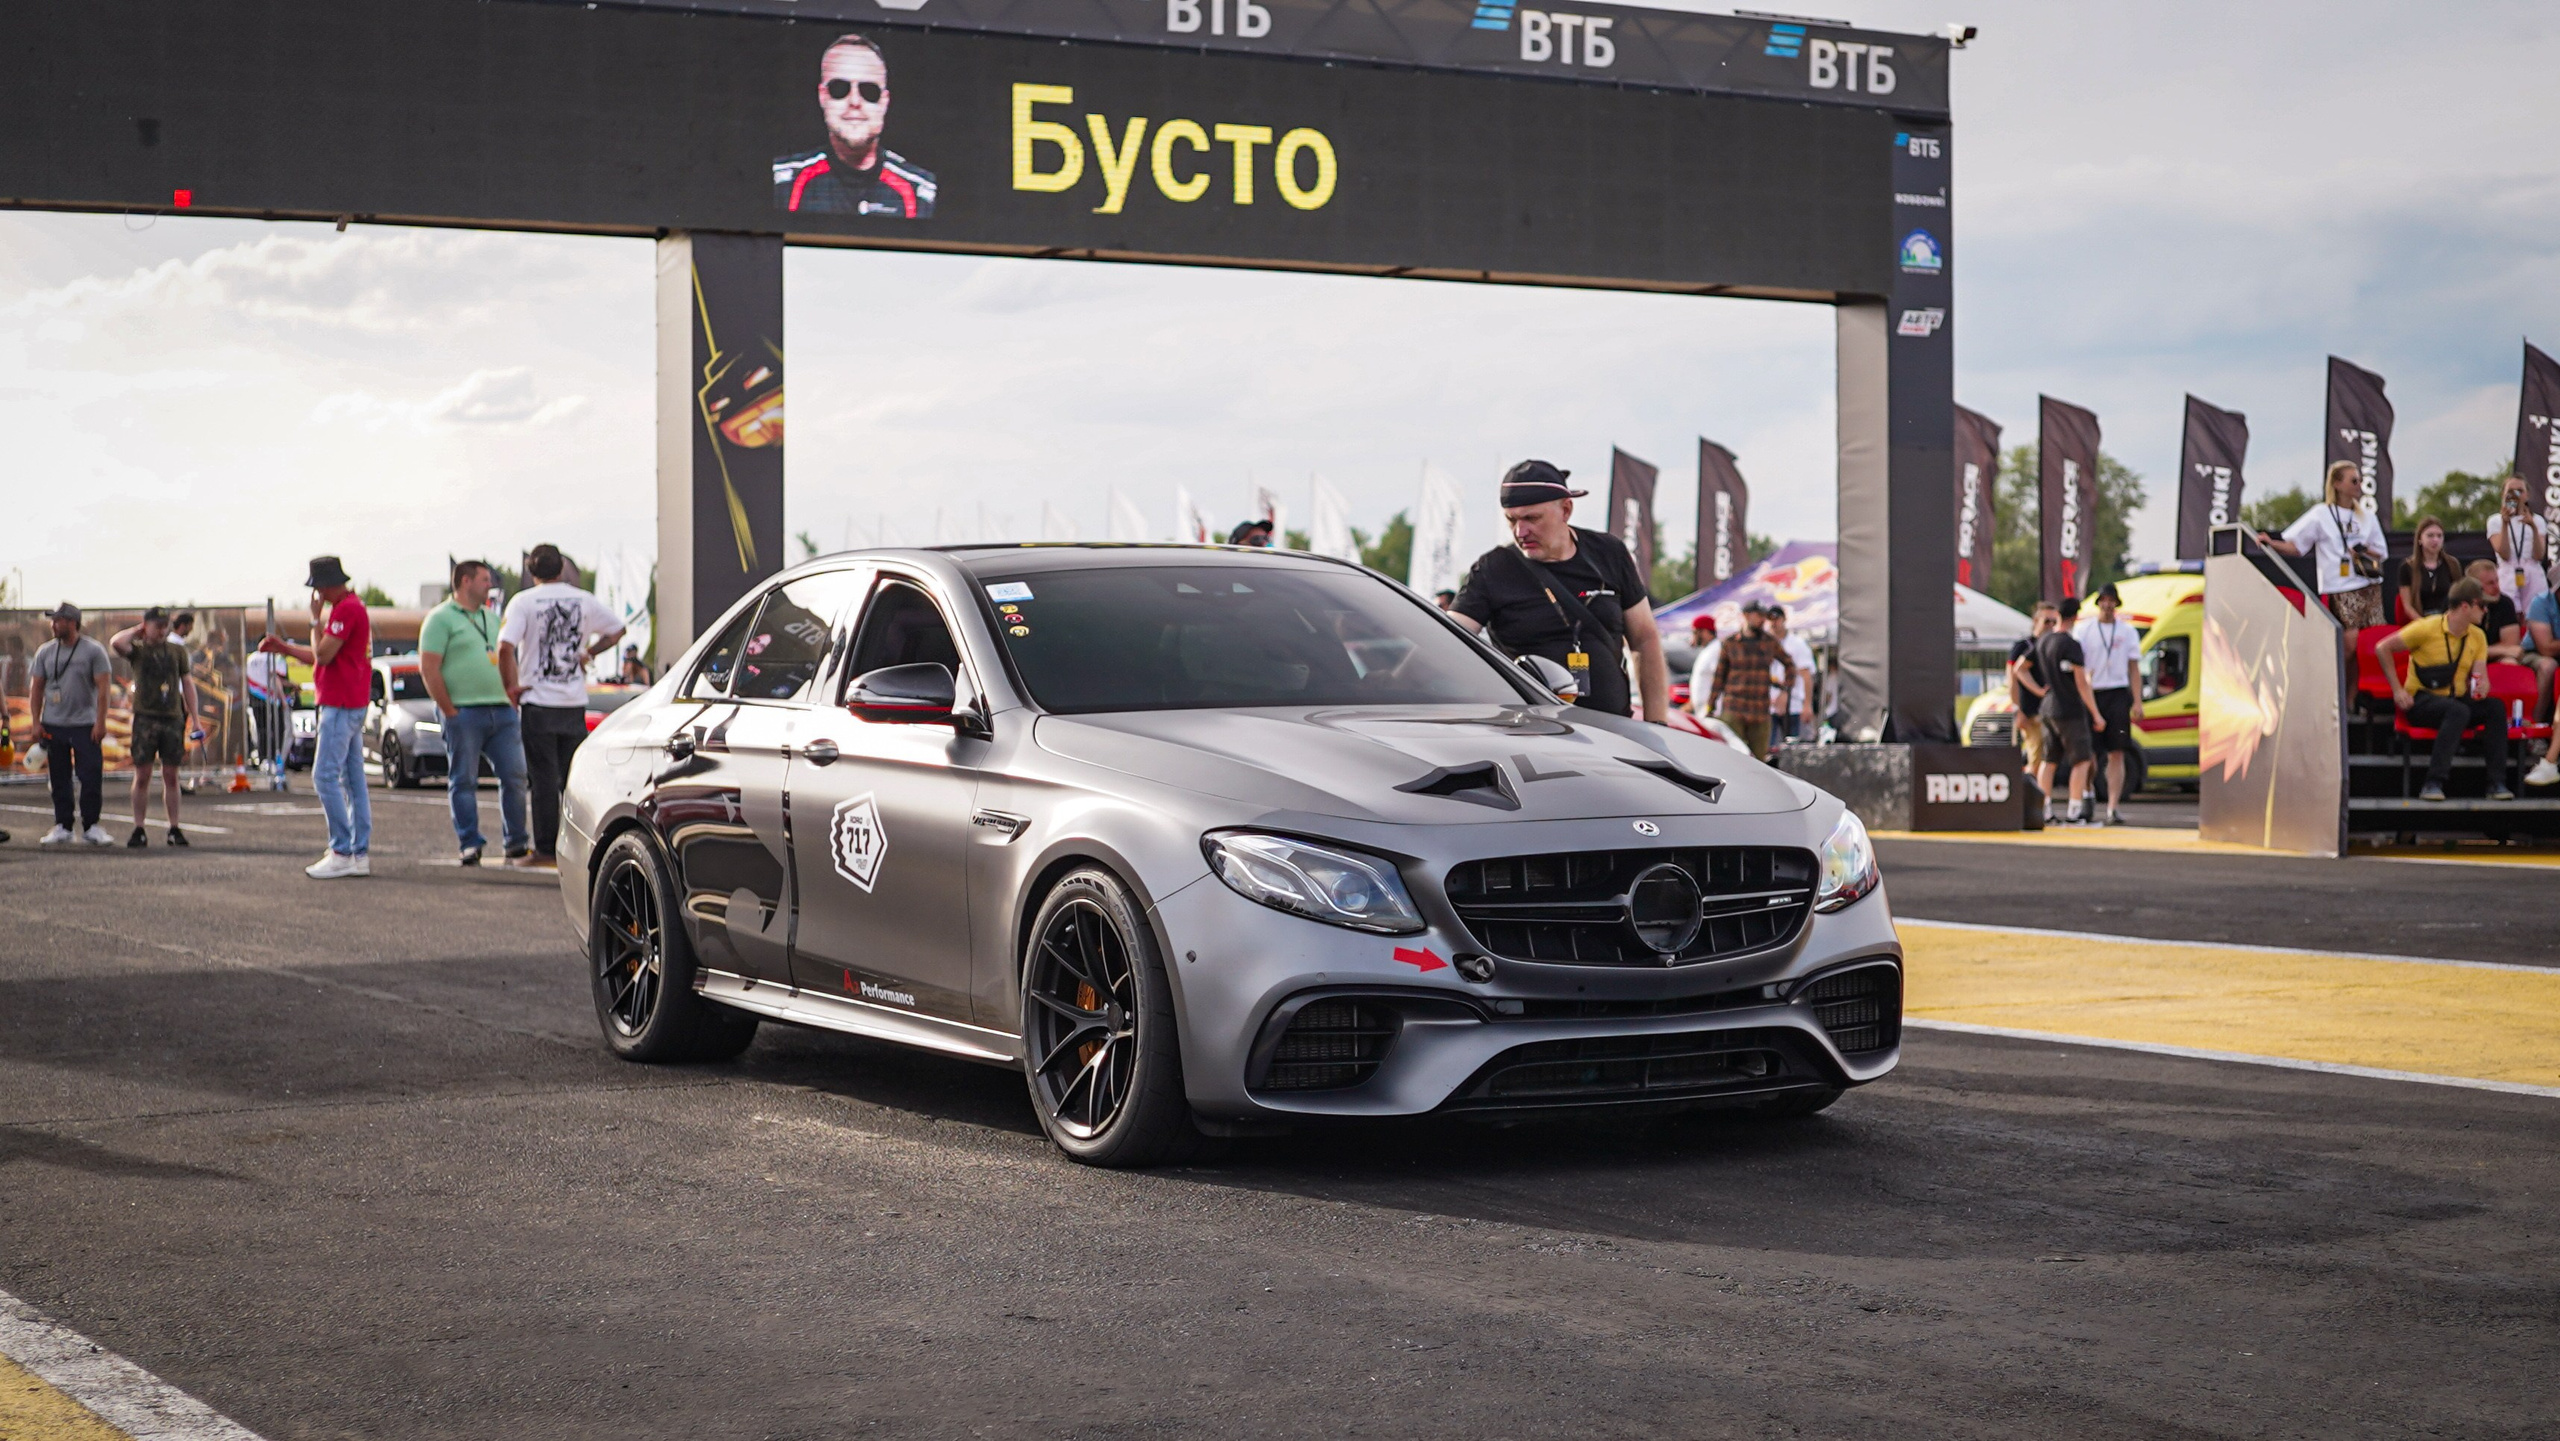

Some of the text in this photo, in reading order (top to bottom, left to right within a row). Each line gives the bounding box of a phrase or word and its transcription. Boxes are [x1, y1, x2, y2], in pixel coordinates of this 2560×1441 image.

[1521, 9, 1615, 68] ВТБ
[1809, 38, 1896, 95] ВТБ
[1012, 82, 1338, 214] Бусто
[1909, 136, 1941, 158] ВТБ
[2209, 466, 2232, 525] ONKI
[2359, 431, 2379, 515] GONKI
[1925, 773, 2010, 803] RDRC
[847, 826, 870, 855] 717
[860, 981, 915, 1006] Performance
